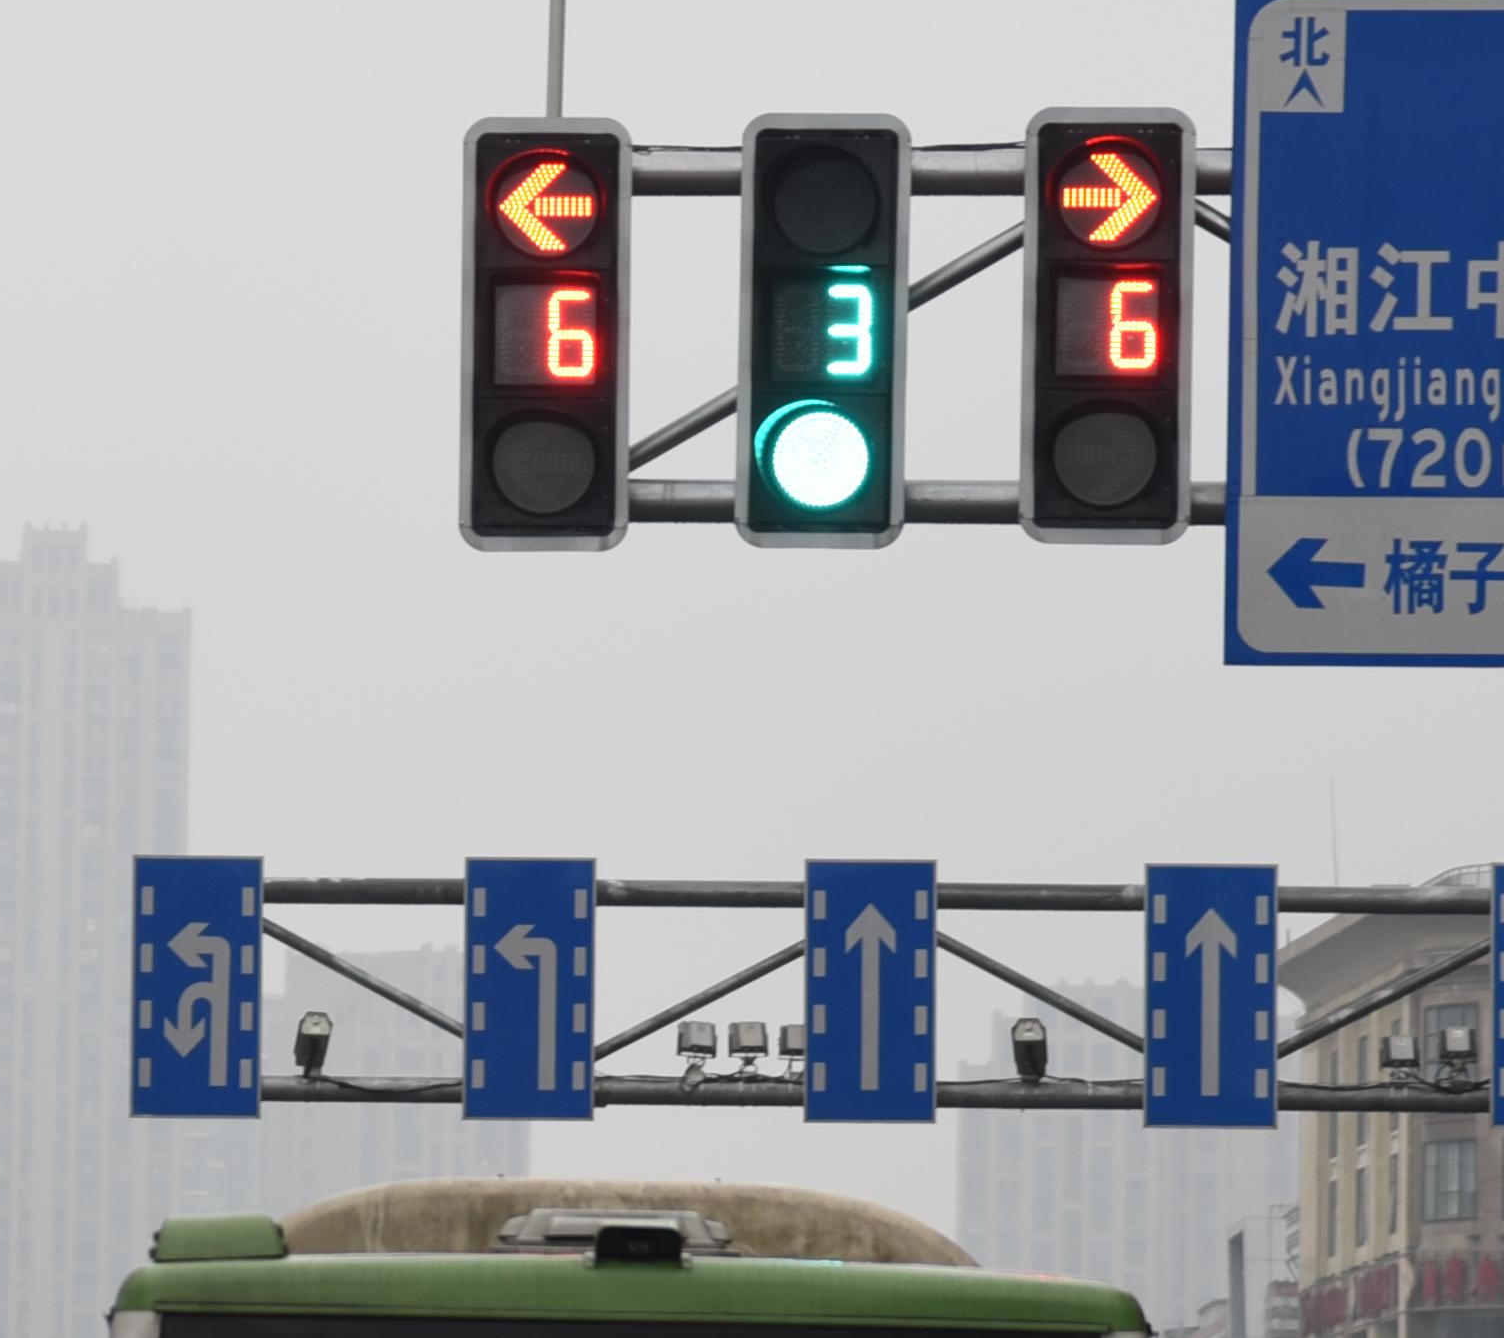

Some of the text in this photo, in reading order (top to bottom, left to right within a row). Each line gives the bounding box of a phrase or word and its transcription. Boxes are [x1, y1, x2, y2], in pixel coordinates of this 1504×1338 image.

[1278, 17, 1331, 67] 北
[546, 290, 594, 378] 6
[826, 284, 873, 376] 3
[1108, 280, 1158, 370] 6
[1273, 356, 1502, 422] Xiangjiang
